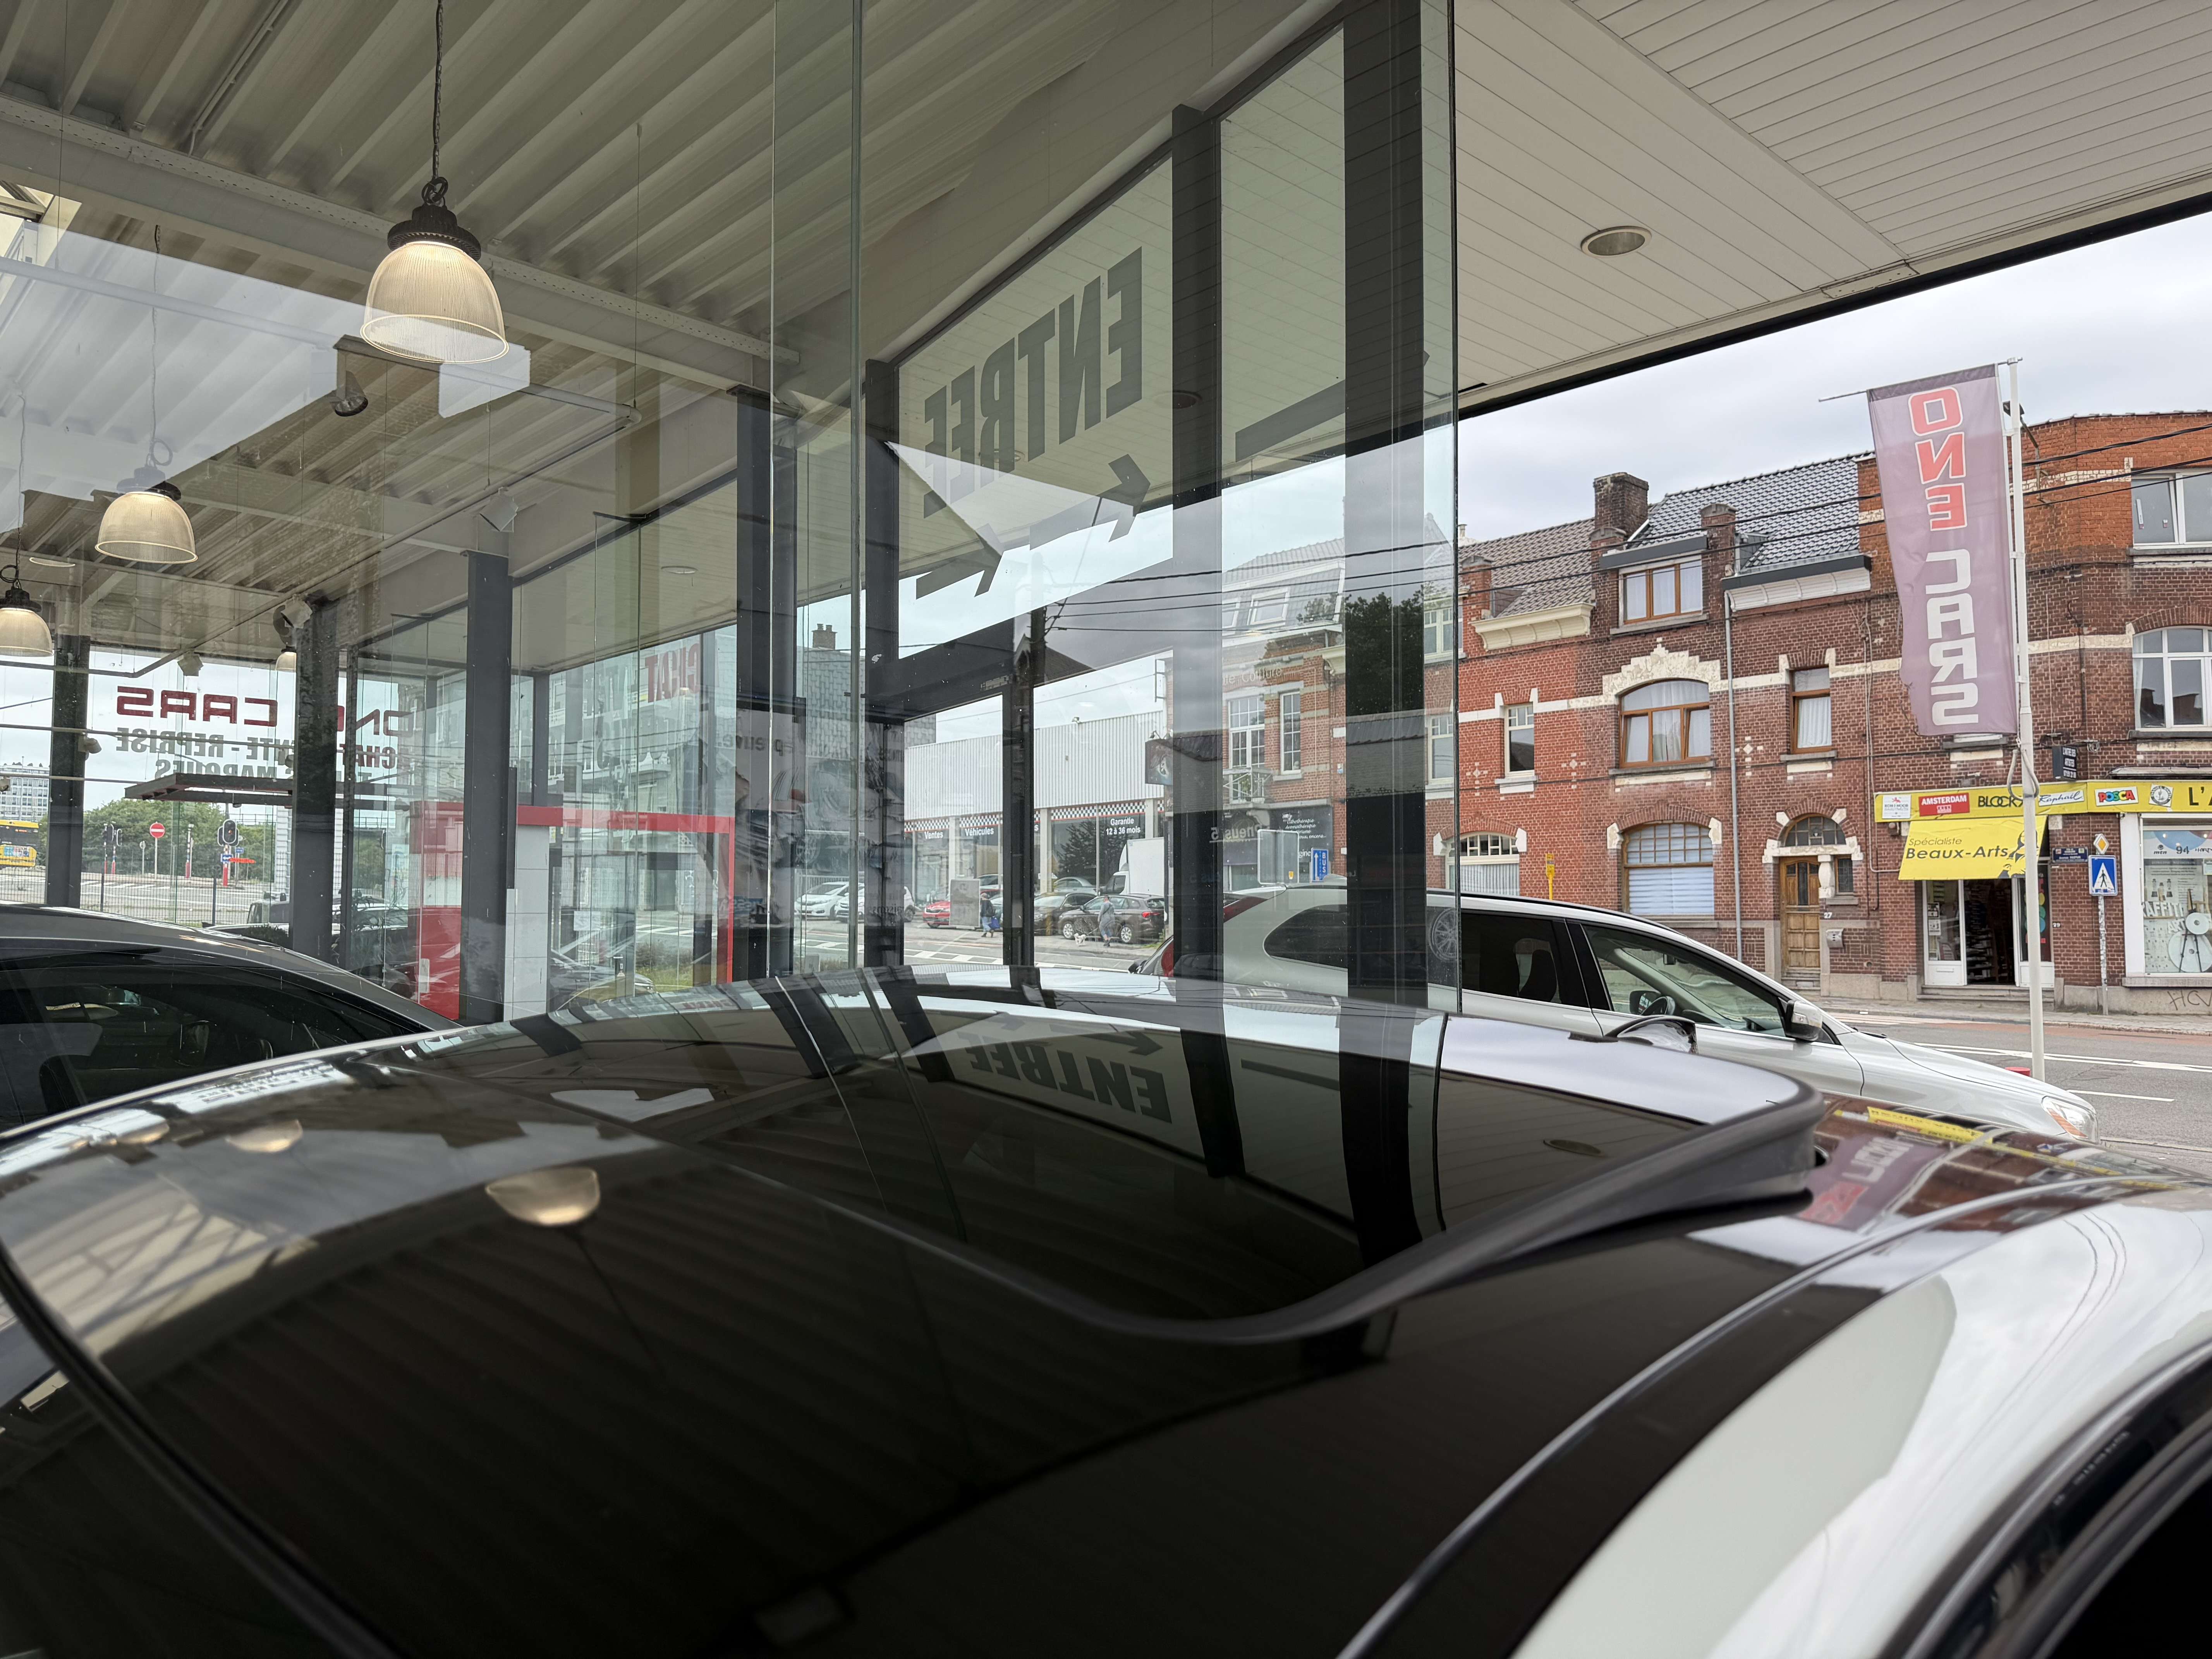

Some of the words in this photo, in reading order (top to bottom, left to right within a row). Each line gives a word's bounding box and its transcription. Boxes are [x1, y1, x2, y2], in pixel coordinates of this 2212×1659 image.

[1921, 795, 1967, 805] AMSTERDAM
[2098, 790, 2136, 803] POSCA
[1110, 817, 1134, 825] Garantie
[965, 827, 994, 836] Véhicules
[1126, 825, 1140, 833] mois
[924, 831, 944, 840] Ventes
[1908, 836, 1962, 847] Spécialiste
[1905, 845, 2009, 859] Beaux-Arts
[957, 1030, 1172, 1124] ENTREE
